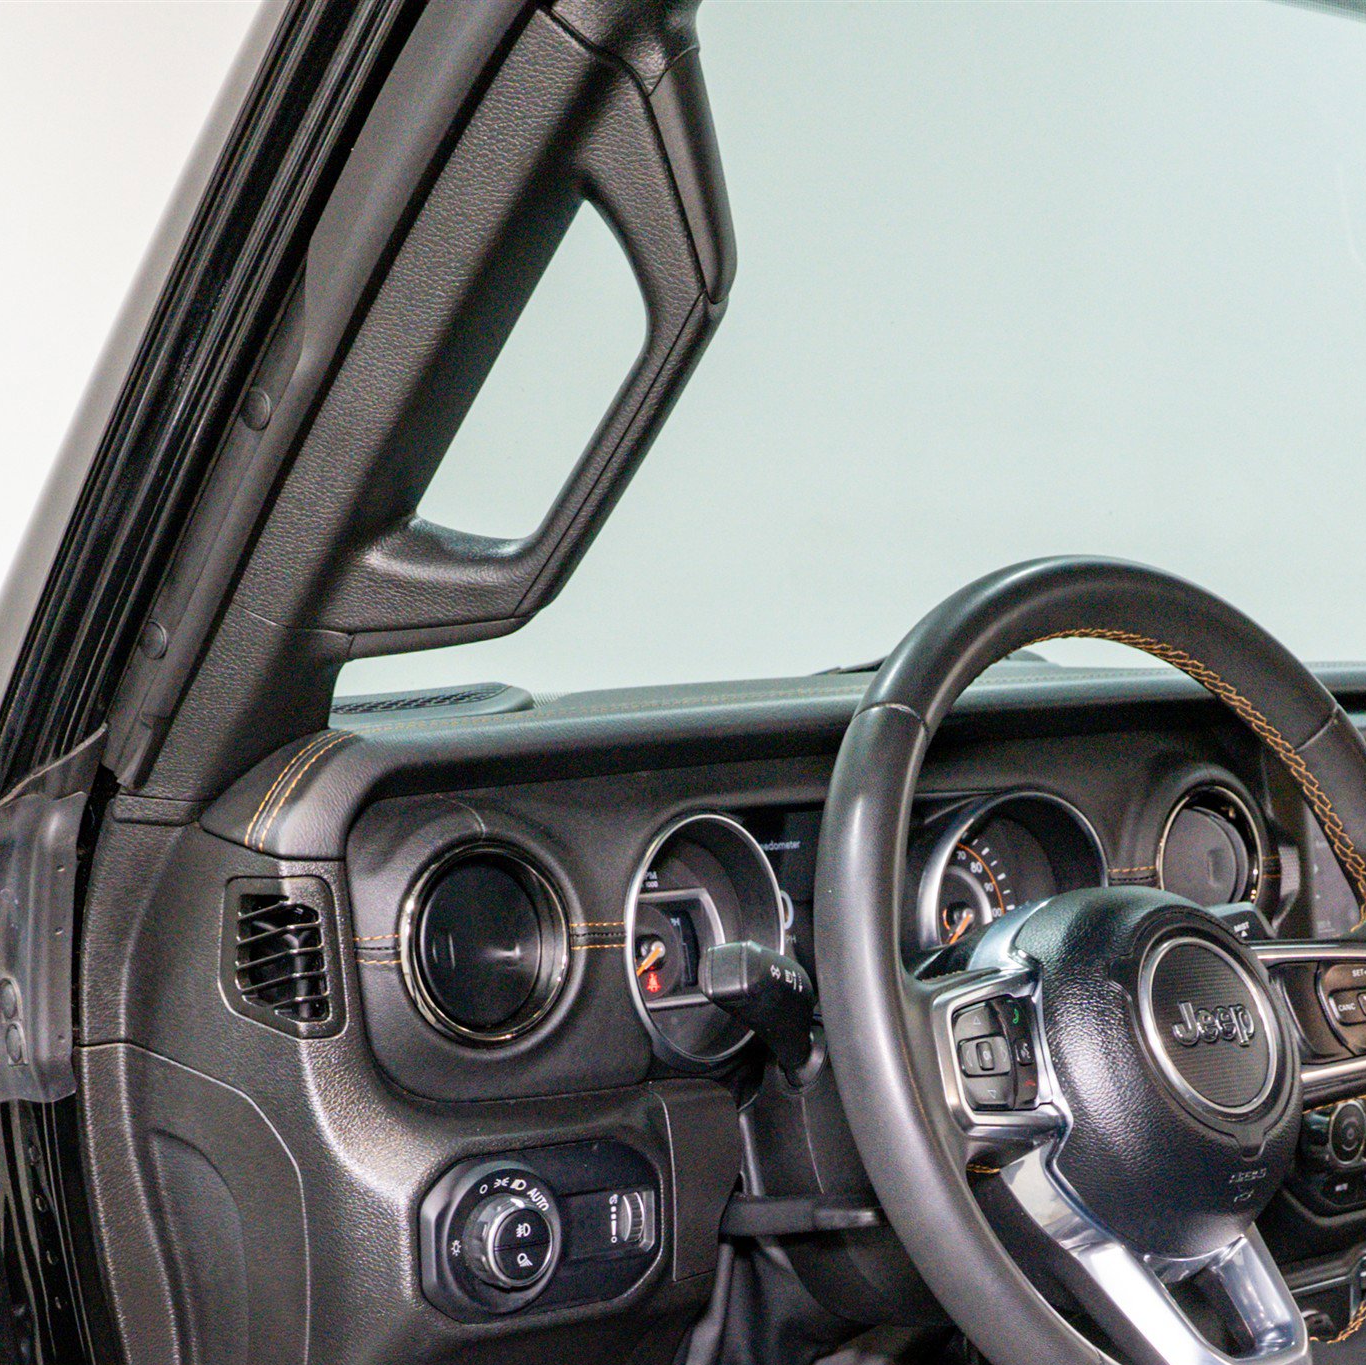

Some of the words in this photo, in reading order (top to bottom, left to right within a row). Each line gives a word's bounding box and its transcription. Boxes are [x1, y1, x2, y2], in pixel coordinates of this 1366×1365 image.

[956, 850, 967, 860] 70
[970, 861, 983, 874] 80
[984, 882, 994, 892] 90
[992, 907, 1002, 918] 00
[1338, 1002, 1356, 1012] CANC
[1172, 1001, 1254, 1047] Jeep
[526, 1187, 550, 1212] AUTO
